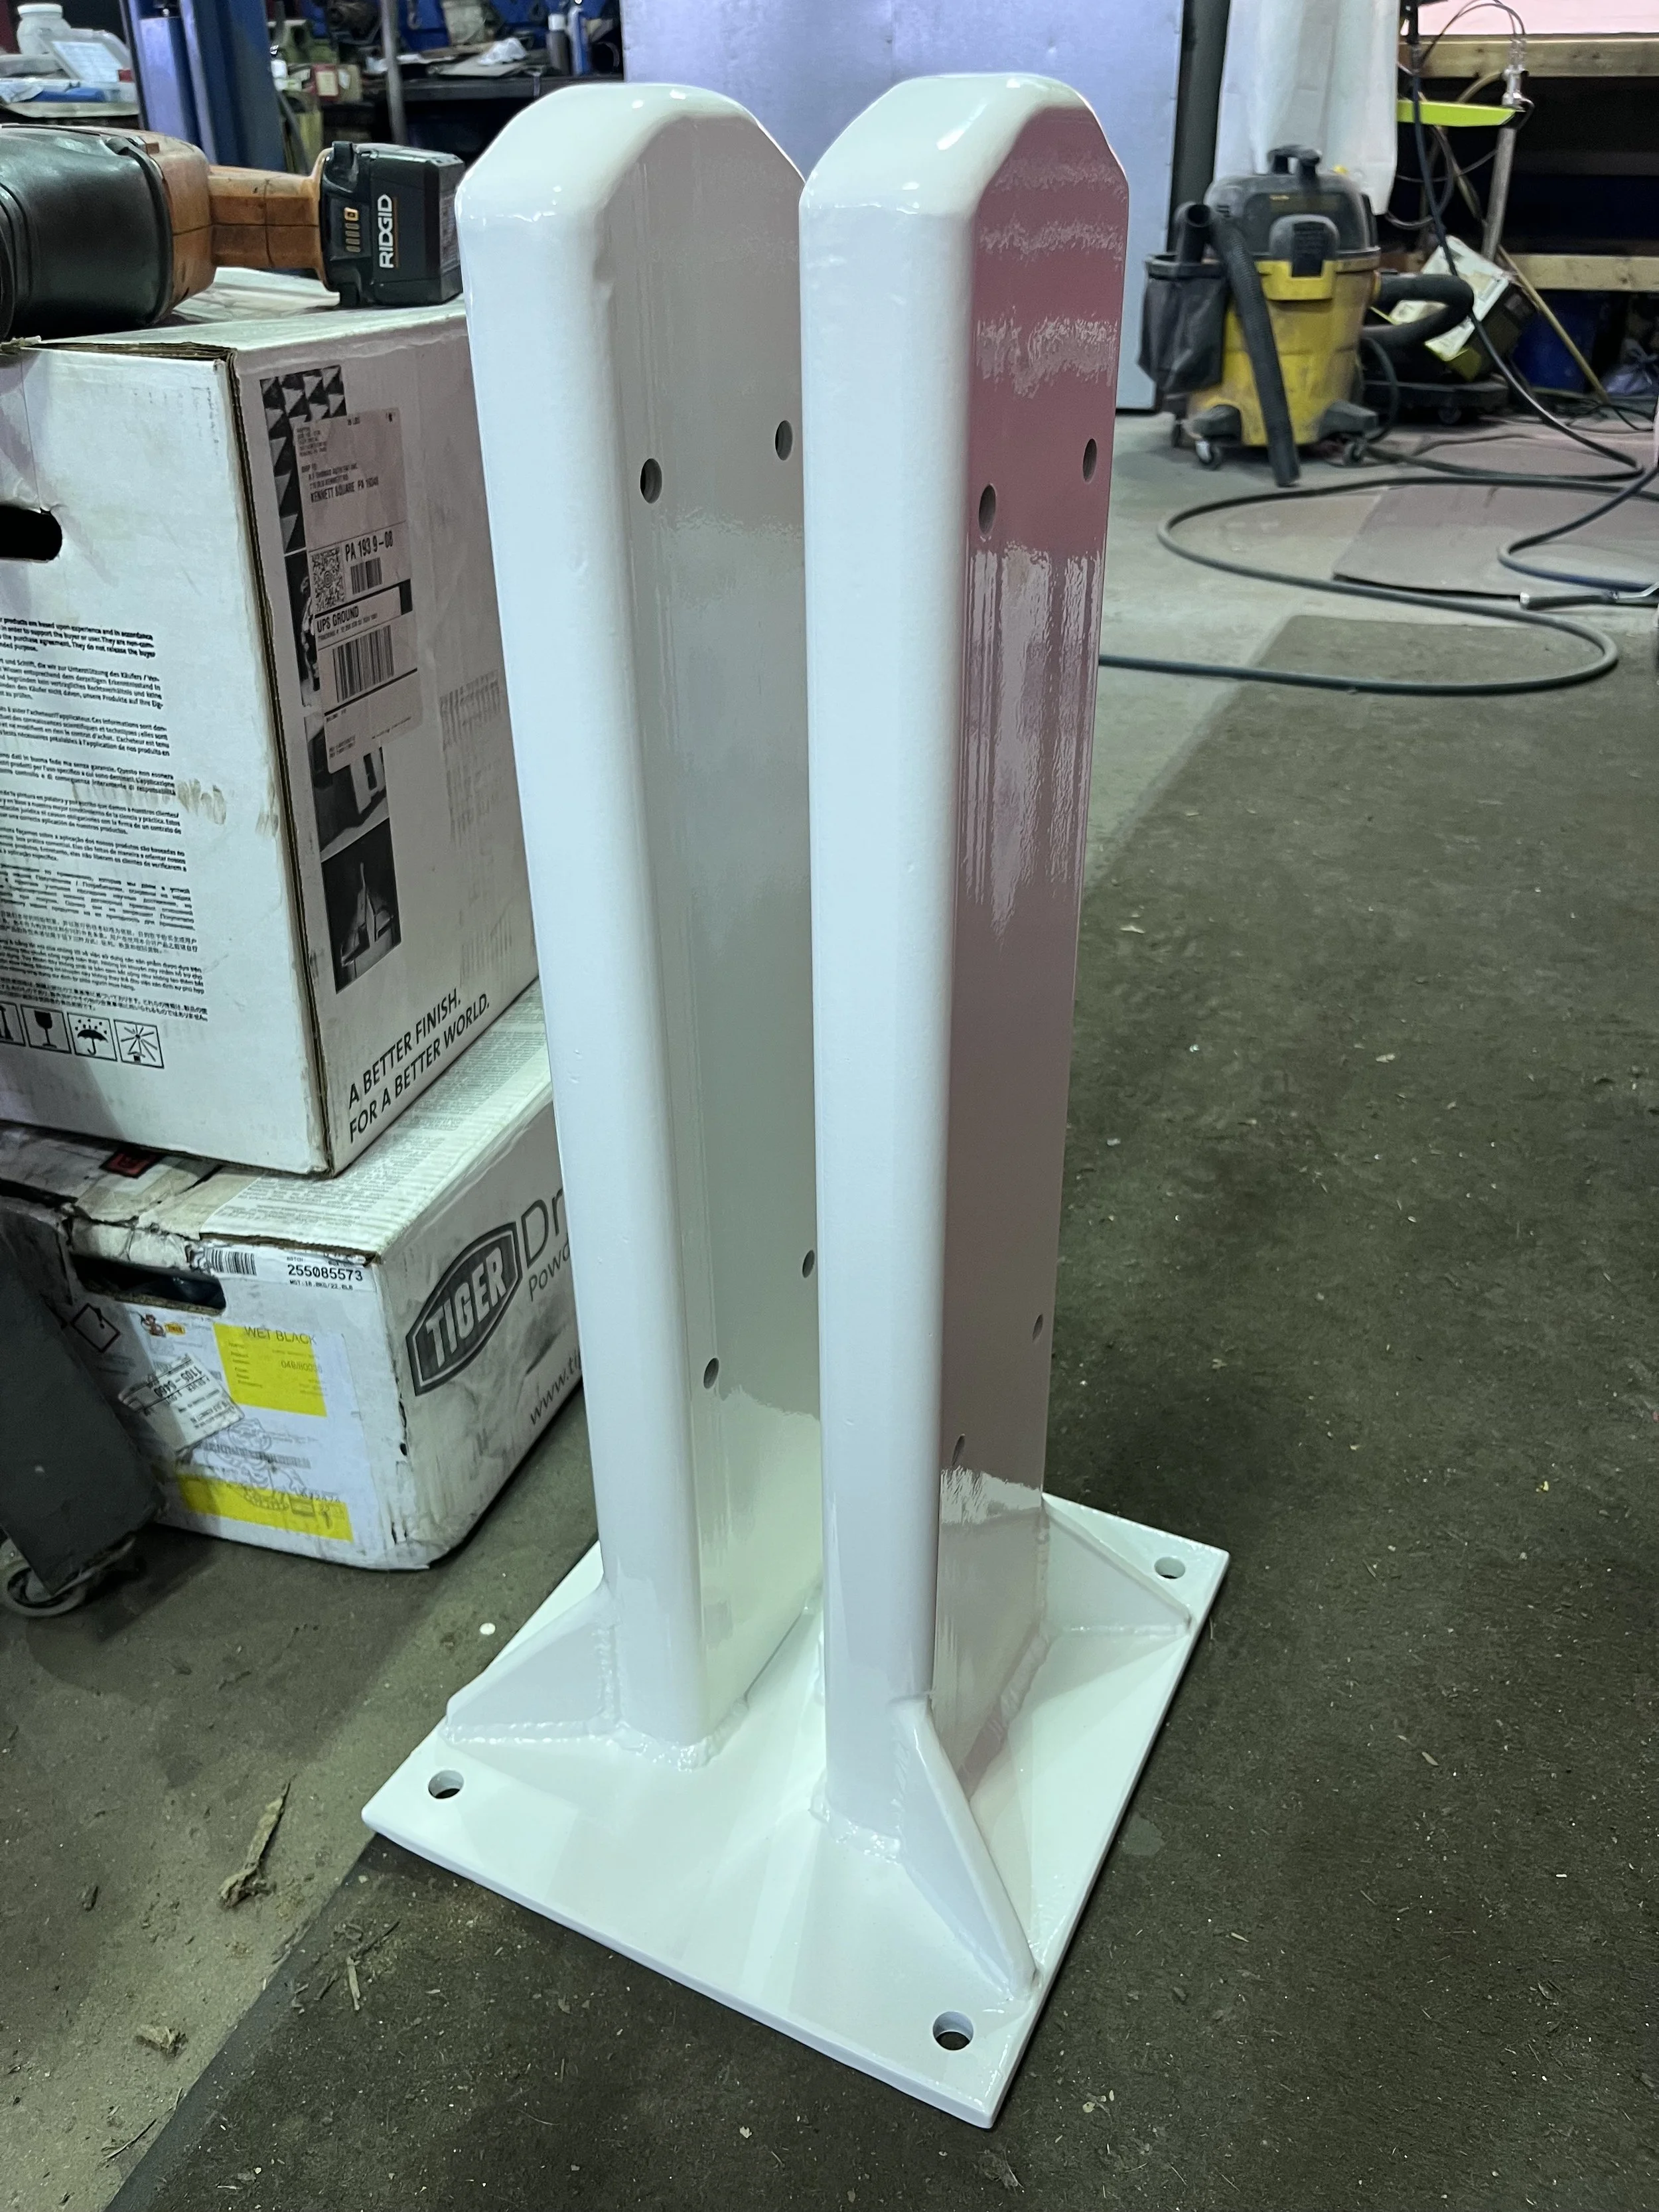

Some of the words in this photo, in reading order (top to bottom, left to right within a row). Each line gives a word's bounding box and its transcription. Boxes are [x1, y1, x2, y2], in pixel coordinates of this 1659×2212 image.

[377, 194, 394, 269] RIDGID
[345, 542, 356, 562] PA
[317, 616, 331, 633] UPS
[332, 605, 360, 627] GROUND
[349, 1082, 360, 1110] A
[363, 1031, 413, 1096] BETTER
[415, 988, 461, 1045] FINISH.
[349, 1099, 378, 1144] FOR
[381, 1088, 392, 1113] A
[394, 1037, 441, 1099] BETTER
[443, 993, 490, 1050] WORLD.
[287, 1264, 363, 1282] 255085573
[425, 1247, 507, 1368] TIGER
[244, 1325, 271, 1340] WET
[276, 1331, 317, 1345] BLACK
